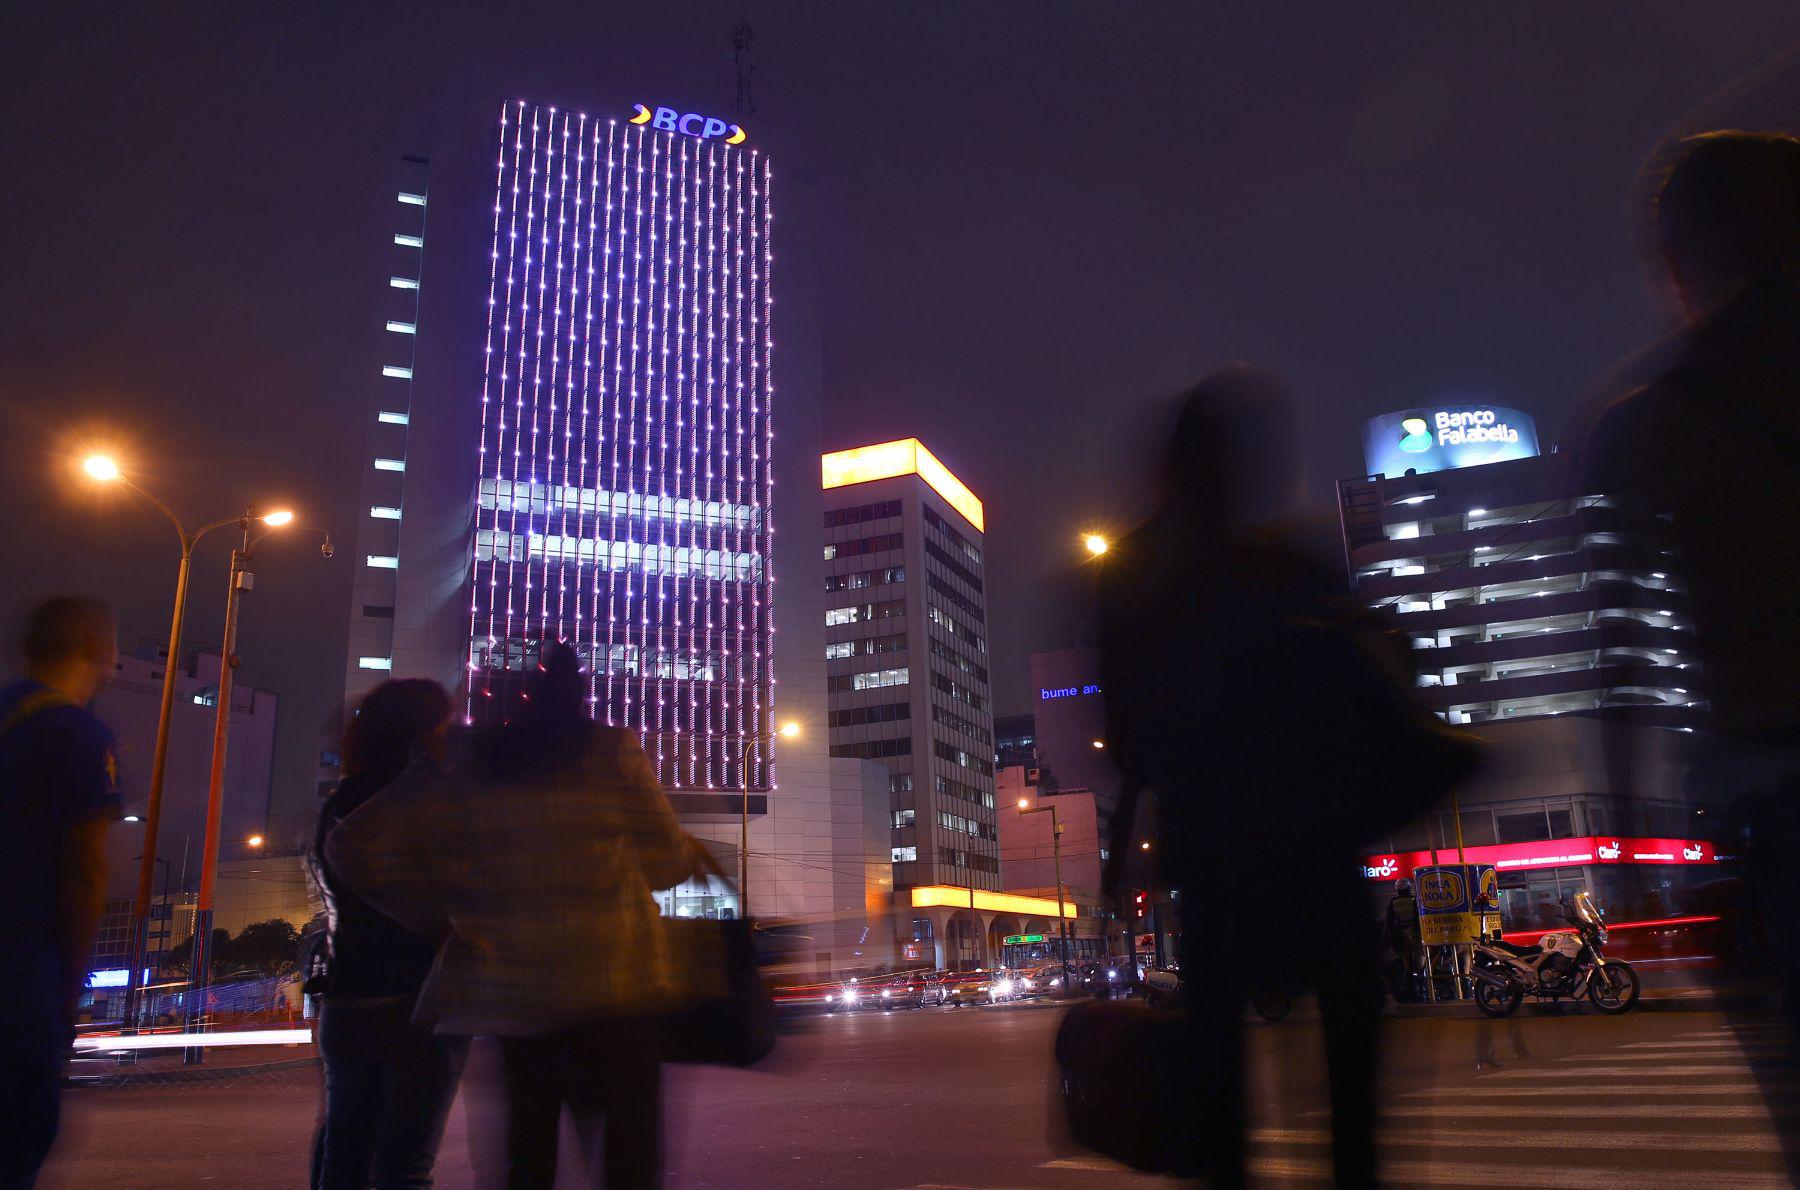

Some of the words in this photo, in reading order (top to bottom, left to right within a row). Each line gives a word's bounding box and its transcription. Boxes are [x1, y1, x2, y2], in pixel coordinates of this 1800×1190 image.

[652, 106, 727, 139] BCP
[1434, 410, 1496, 430] Banco
[1437, 423, 1519, 447] Falabella
[1360, 860, 1396, 878] laro
[1424, 879, 1452, 890] INCA
[1424, 891, 1454, 902] KOLA
